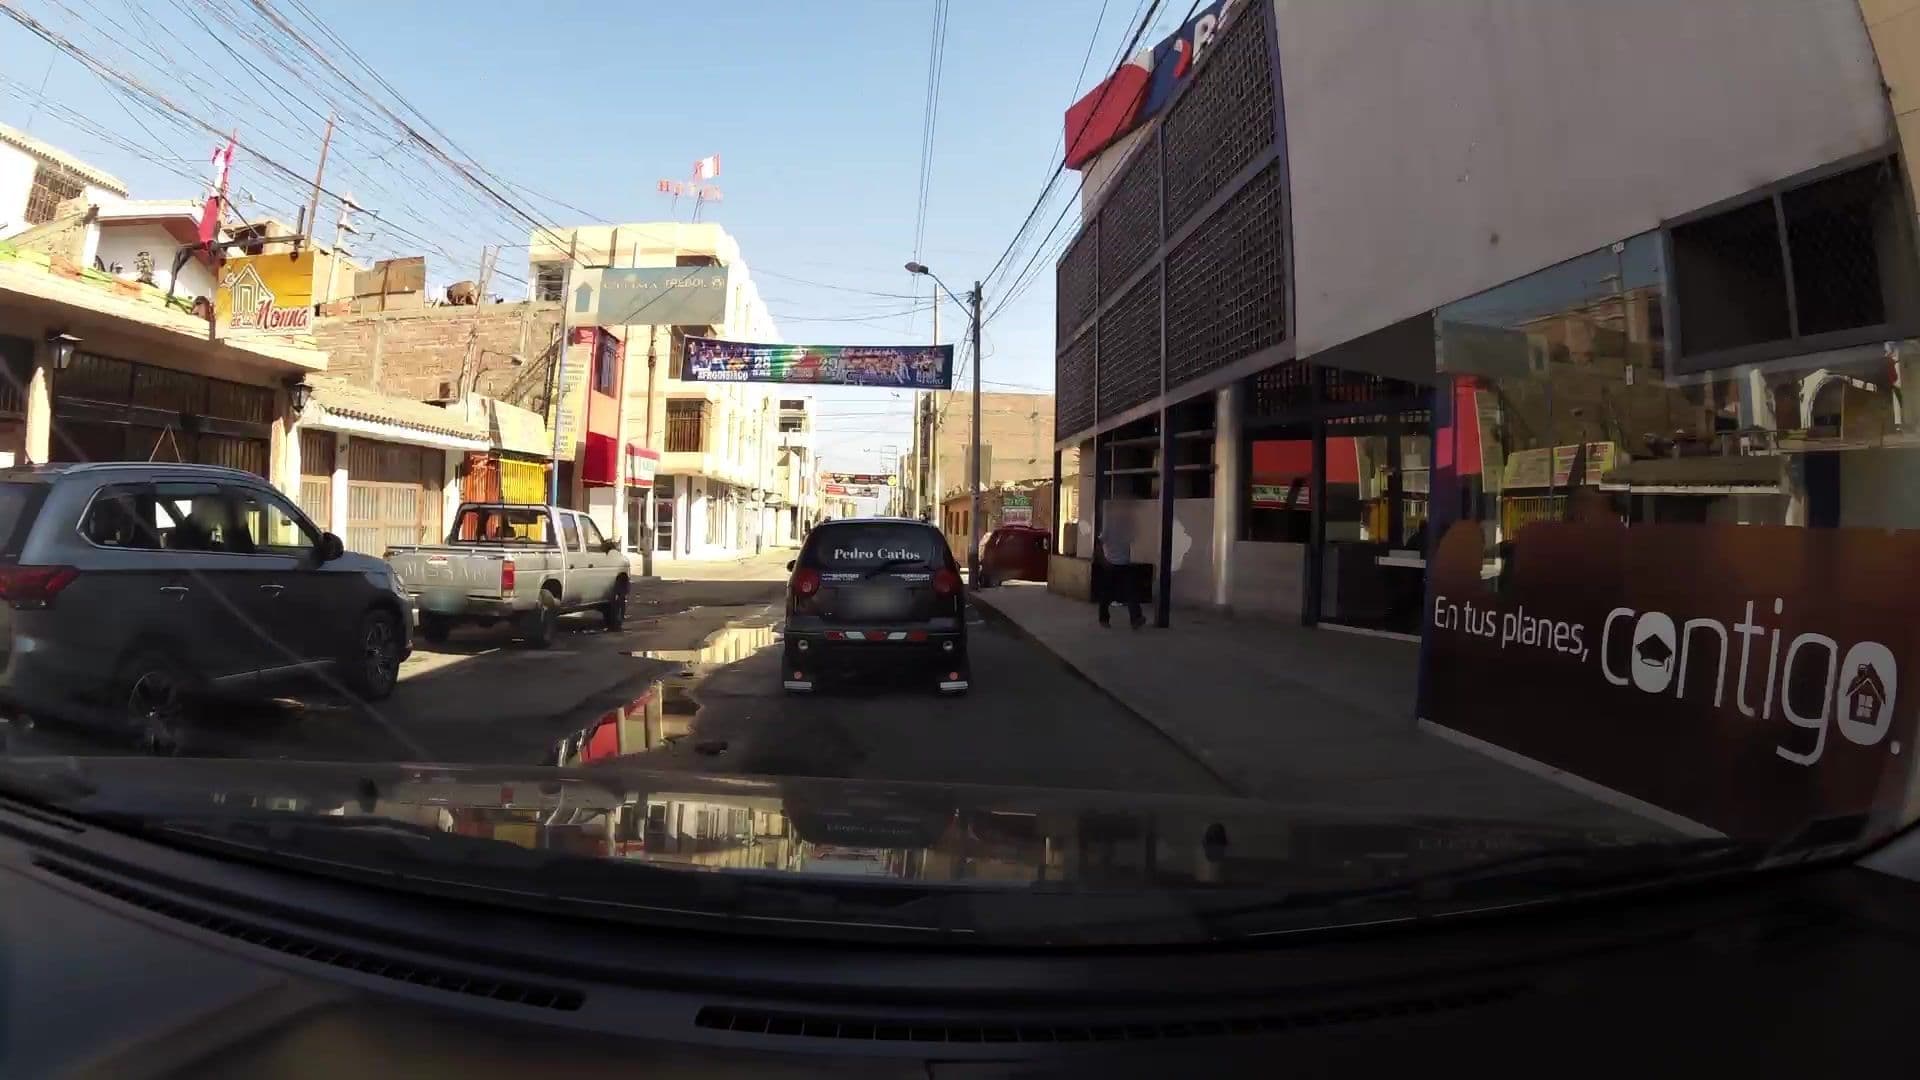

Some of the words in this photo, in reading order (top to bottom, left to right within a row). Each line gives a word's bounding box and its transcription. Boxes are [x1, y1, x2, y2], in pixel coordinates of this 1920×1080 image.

[255, 299, 308, 330] Nonna
[833, 547, 874, 560] Pedro
[877, 547, 921, 561] Carlos
[1434, 595, 1459, 631] En
[1463, 601, 1497, 638] tus
[1501, 604, 1590, 664] planes,
